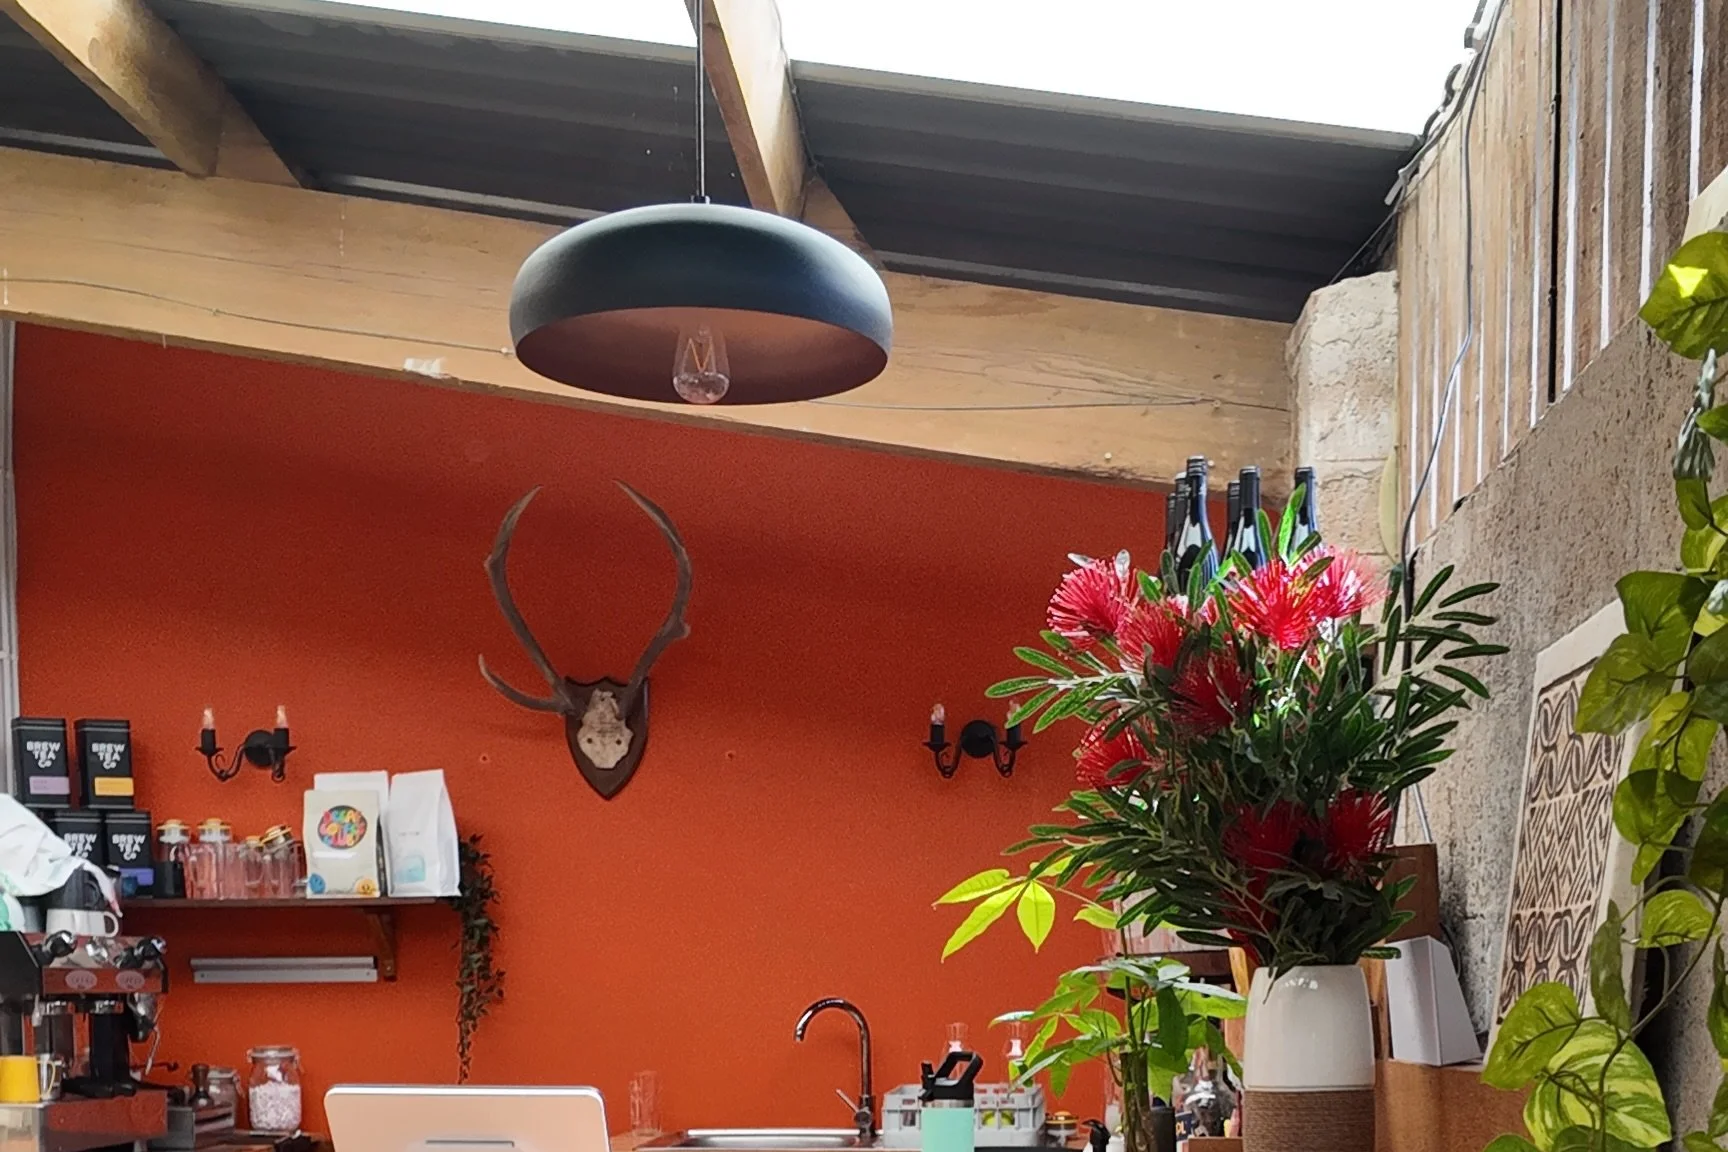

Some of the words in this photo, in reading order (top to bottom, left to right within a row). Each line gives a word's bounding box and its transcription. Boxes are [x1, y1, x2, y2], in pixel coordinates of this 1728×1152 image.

[26, 741, 60, 752] BREW
[91, 743, 125, 753] BREW
[33, 750, 56, 760] TEA
[97, 751, 120, 761] TEA
[112, 835, 146, 844] BREW
[118, 843, 141, 853] TEA
